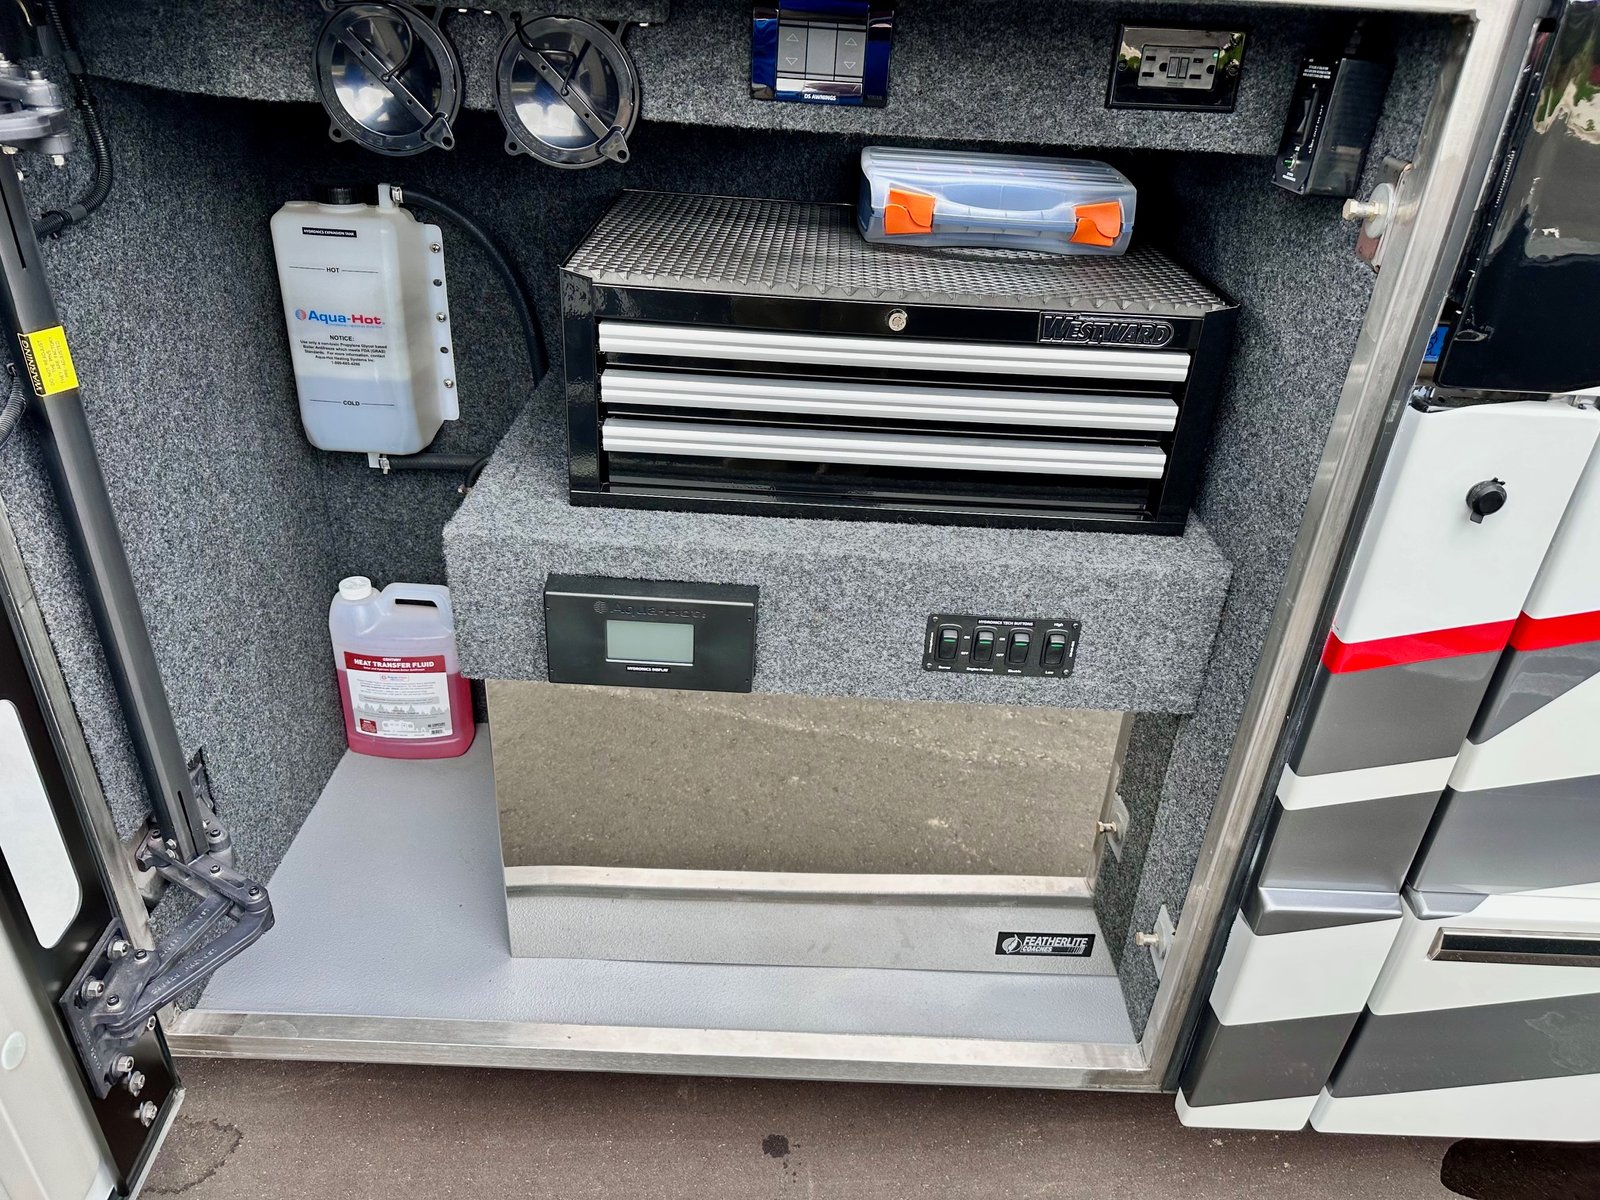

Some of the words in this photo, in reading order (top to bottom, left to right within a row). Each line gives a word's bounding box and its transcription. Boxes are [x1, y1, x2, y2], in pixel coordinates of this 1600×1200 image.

[308, 310, 381, 324] Aqua-Hot
[1042, 316, 1169, 344] WESTWARD
[22, 340, 42, 390] WARNING
[1023, 936, 1088, 947] FEATHERLITE
